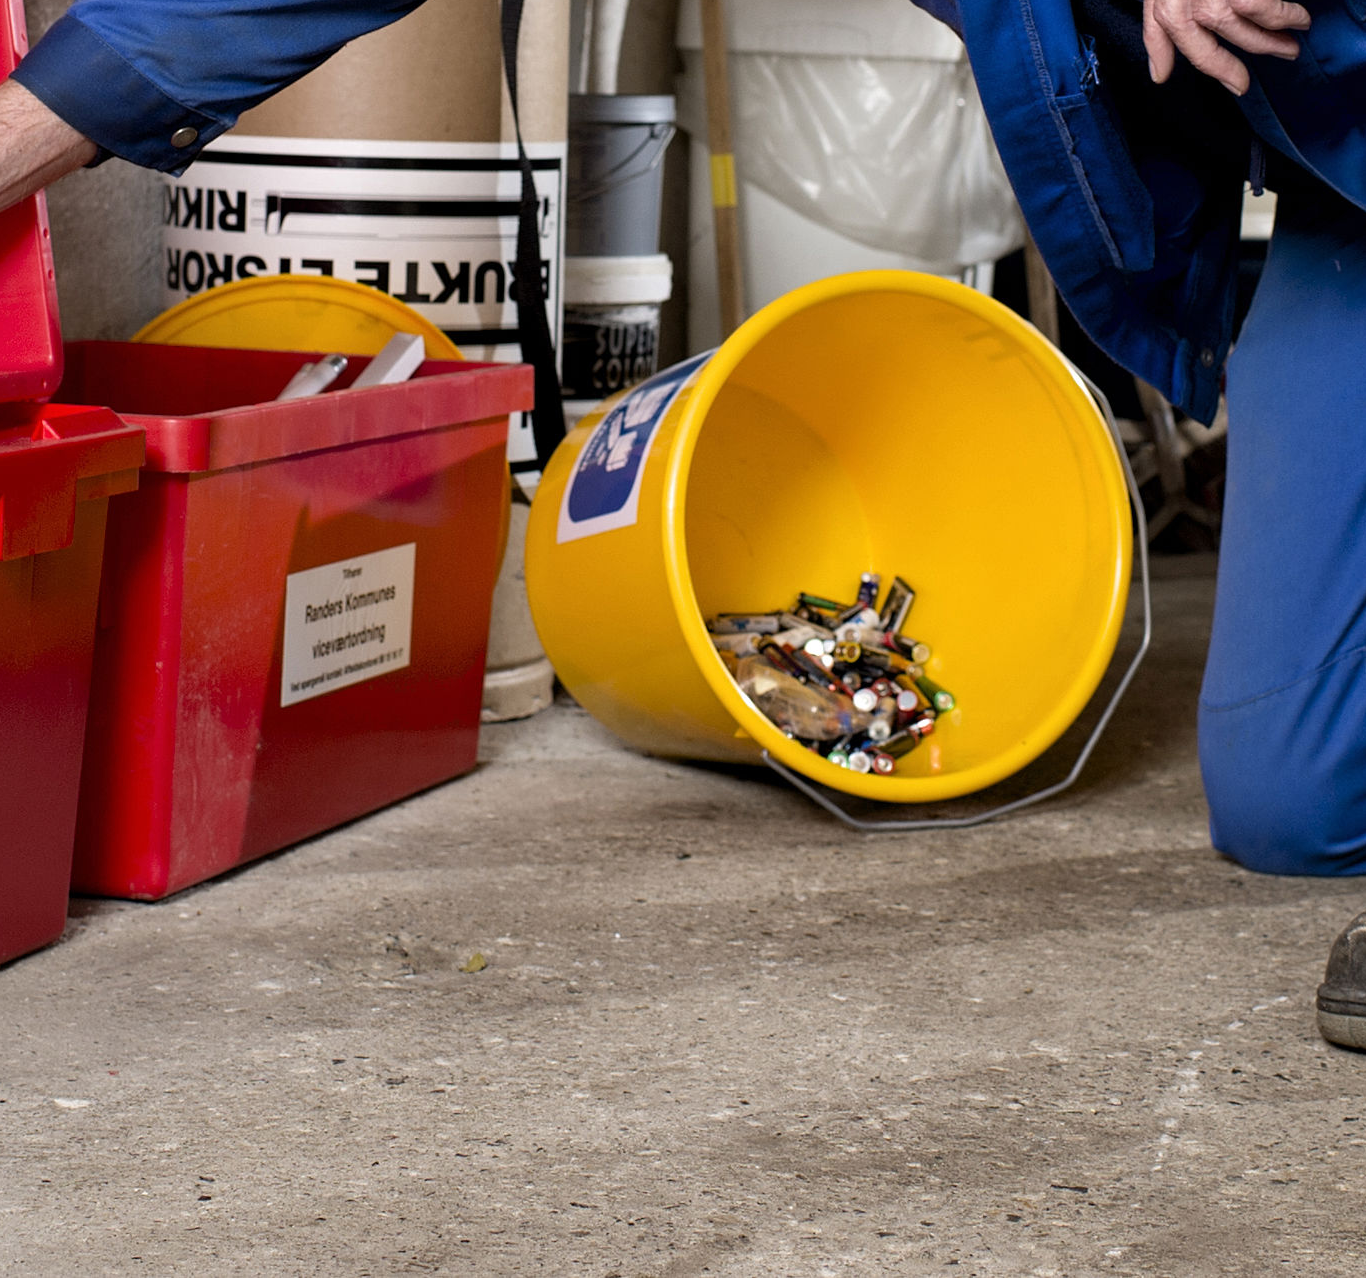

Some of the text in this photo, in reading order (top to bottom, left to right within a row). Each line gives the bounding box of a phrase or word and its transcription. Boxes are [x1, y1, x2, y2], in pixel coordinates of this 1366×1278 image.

[163, 184, 246, 233] RIKK
[305, 585, 396, 623] Randers Kommunes
